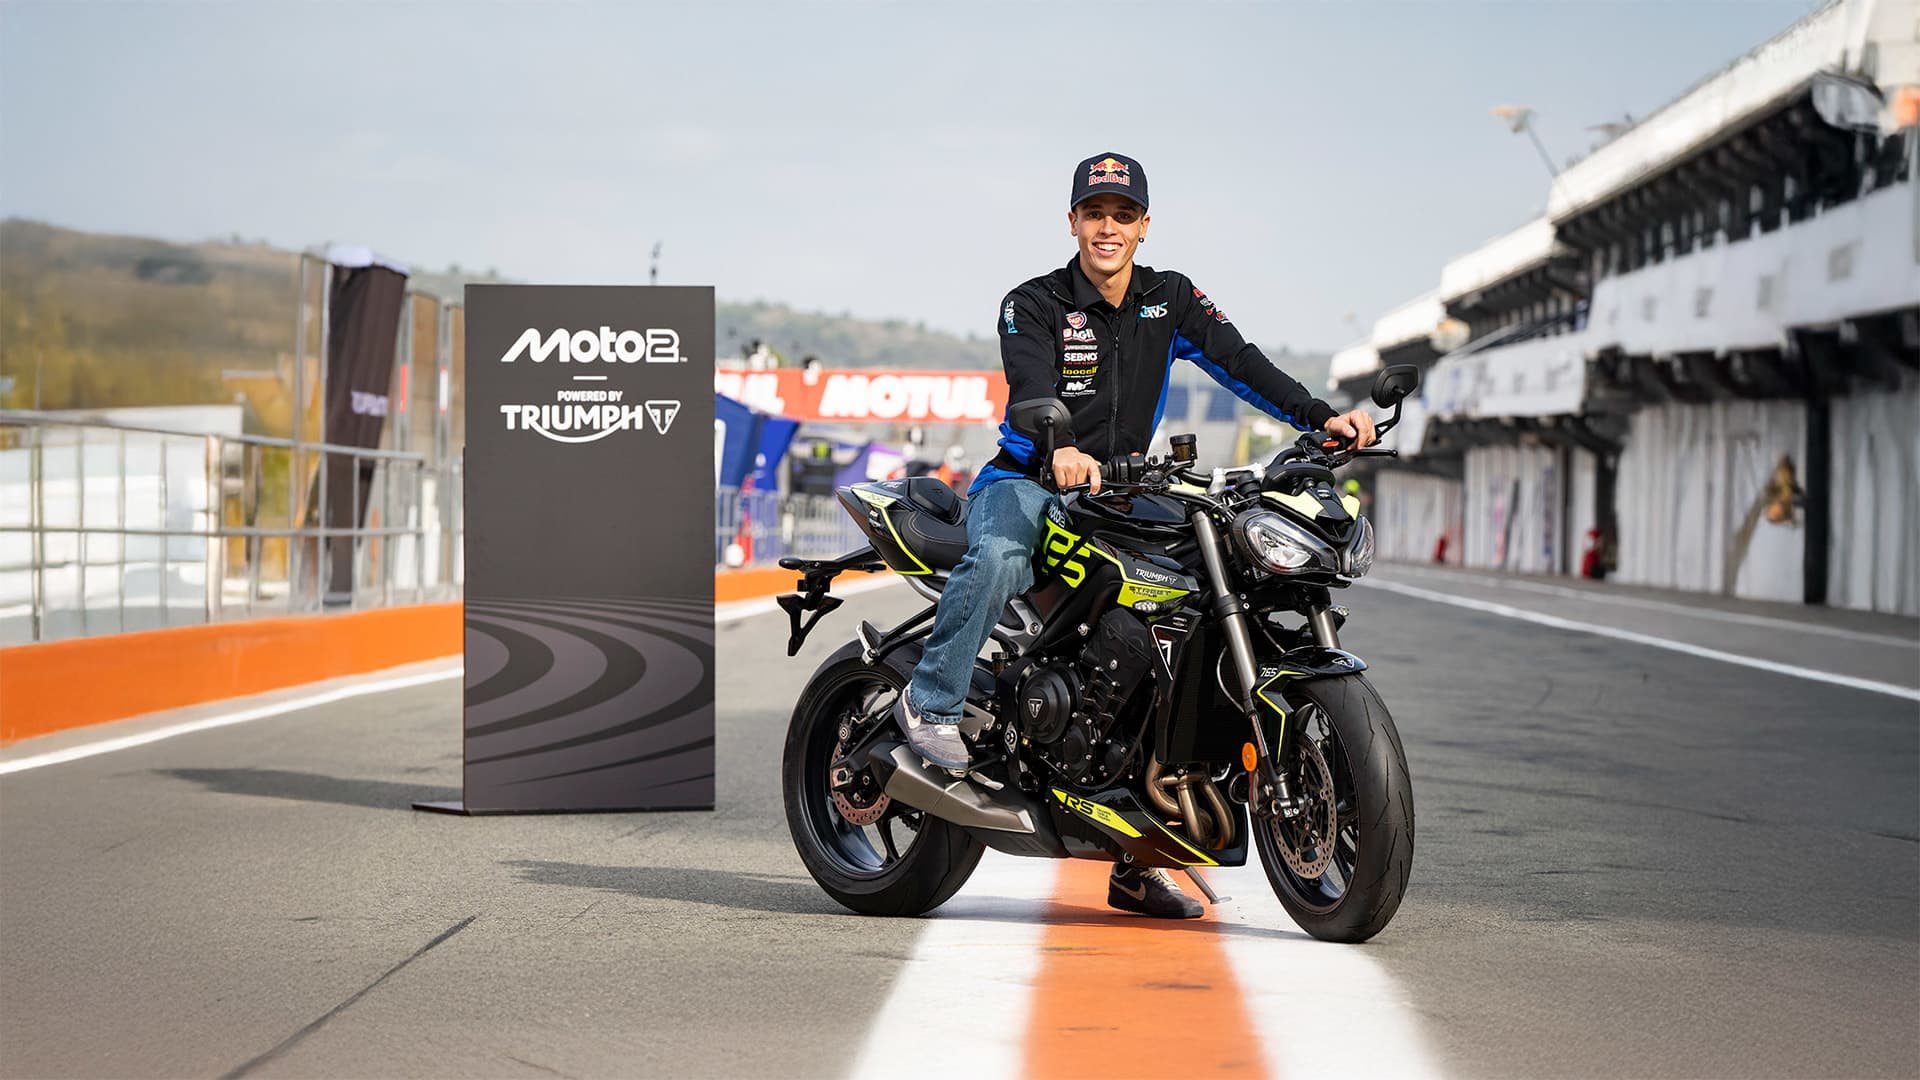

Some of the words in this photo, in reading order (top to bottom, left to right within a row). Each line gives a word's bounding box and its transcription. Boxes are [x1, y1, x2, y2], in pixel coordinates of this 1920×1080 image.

[1088, 172, 1109, 186] Red
[1110, 173, 1130, 187] Bull
[500, 326, 680, 363] Moto2
[557, 390, 607, 402] POWERED
[608, 390, 624, 401] BY
[818, 374, 994, 419] MOTUL
[500, 405, 643, 443] TRIUMPH
[1135, 567, 1169, 583] TRIUMPH
[1128, 585, 1172, 596] STREET
[1260, 667, 1279, 678] 765
[1064, 793, 1095, 815] RS
